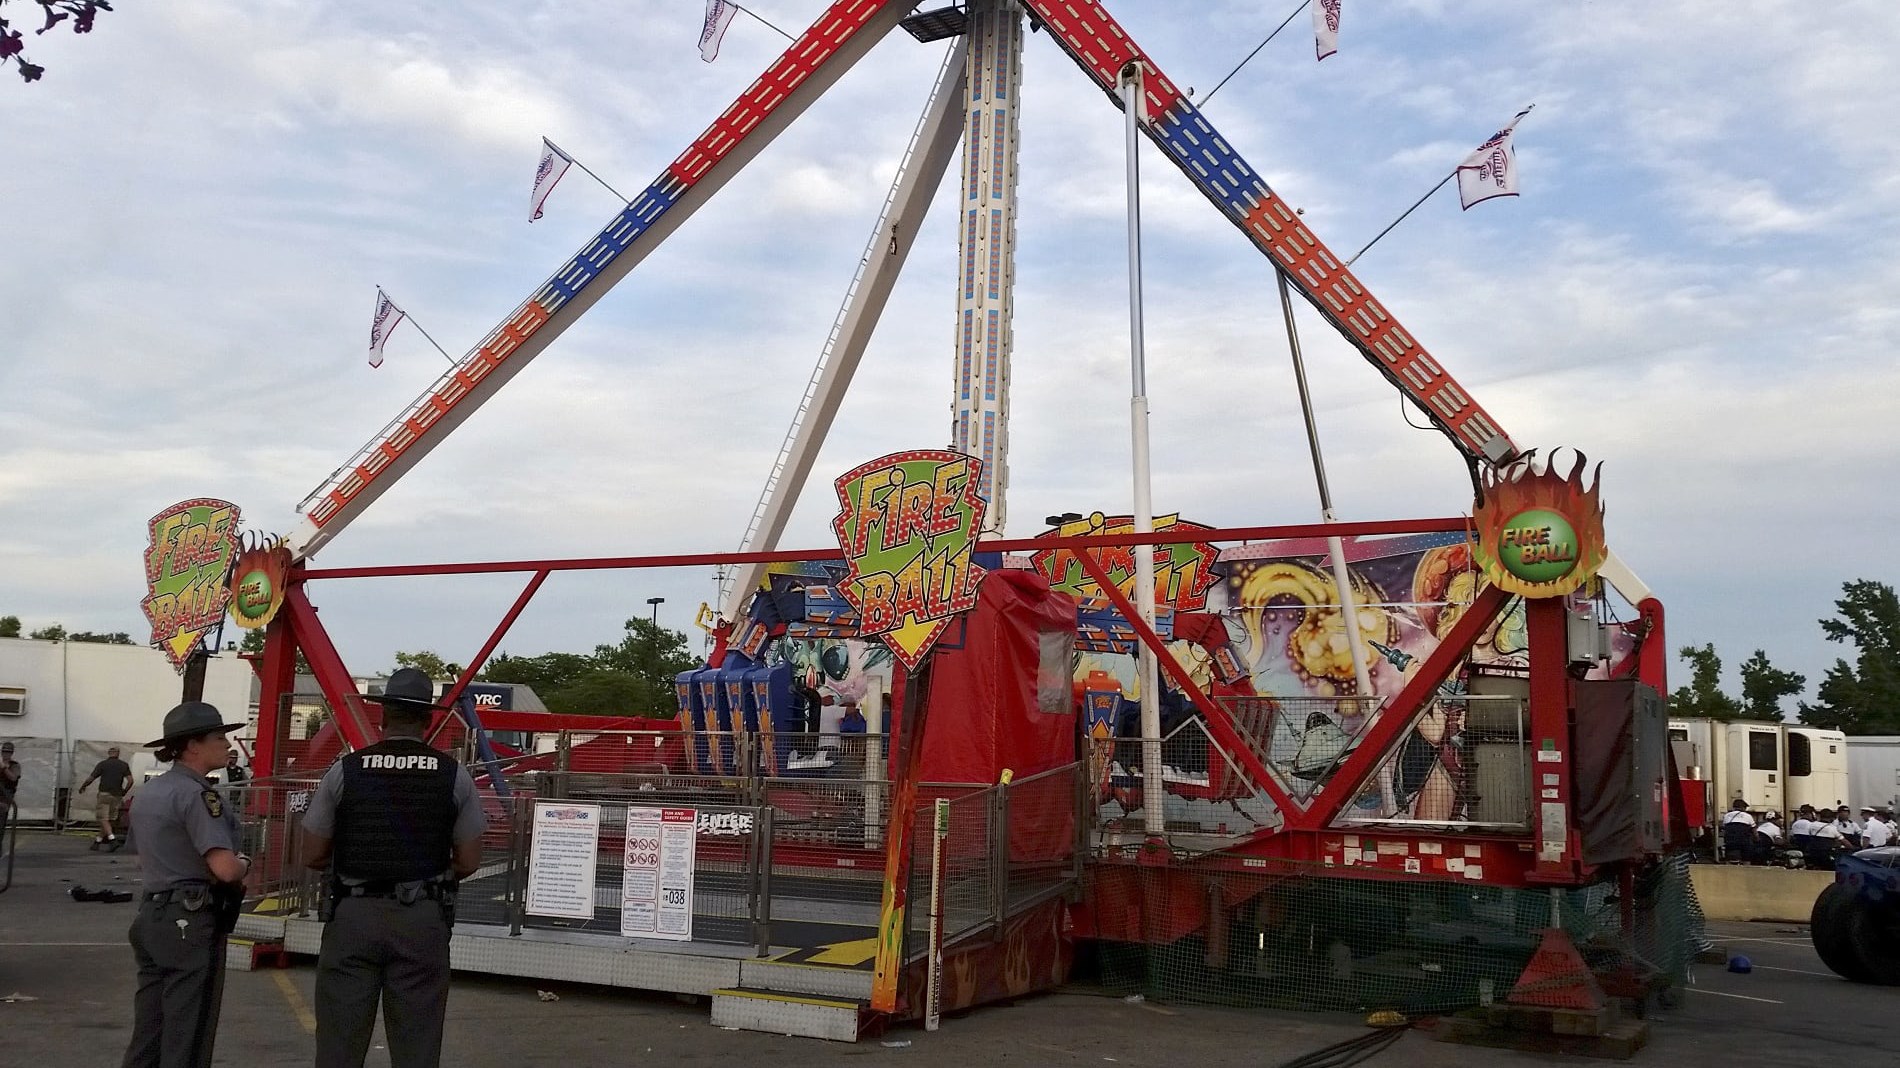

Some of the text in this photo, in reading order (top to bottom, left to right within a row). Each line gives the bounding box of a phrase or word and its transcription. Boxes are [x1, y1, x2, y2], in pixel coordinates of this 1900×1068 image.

[1502, 525, 1551, 548] FIRE
[1521, 542, 1573, 565] BALL
[240, 581, 261, 597] FIRE
[856, 540, 979, 637] BALL
[150, 570, 228, 645] BALL
[246, 593, 269, 607] BALL
[474, 693, 502, 706] YRC
[361, 754, 438, 771] TROOPER
[698, 812, 753, 829] ENTER
[669, 891, 685, 905] 038
